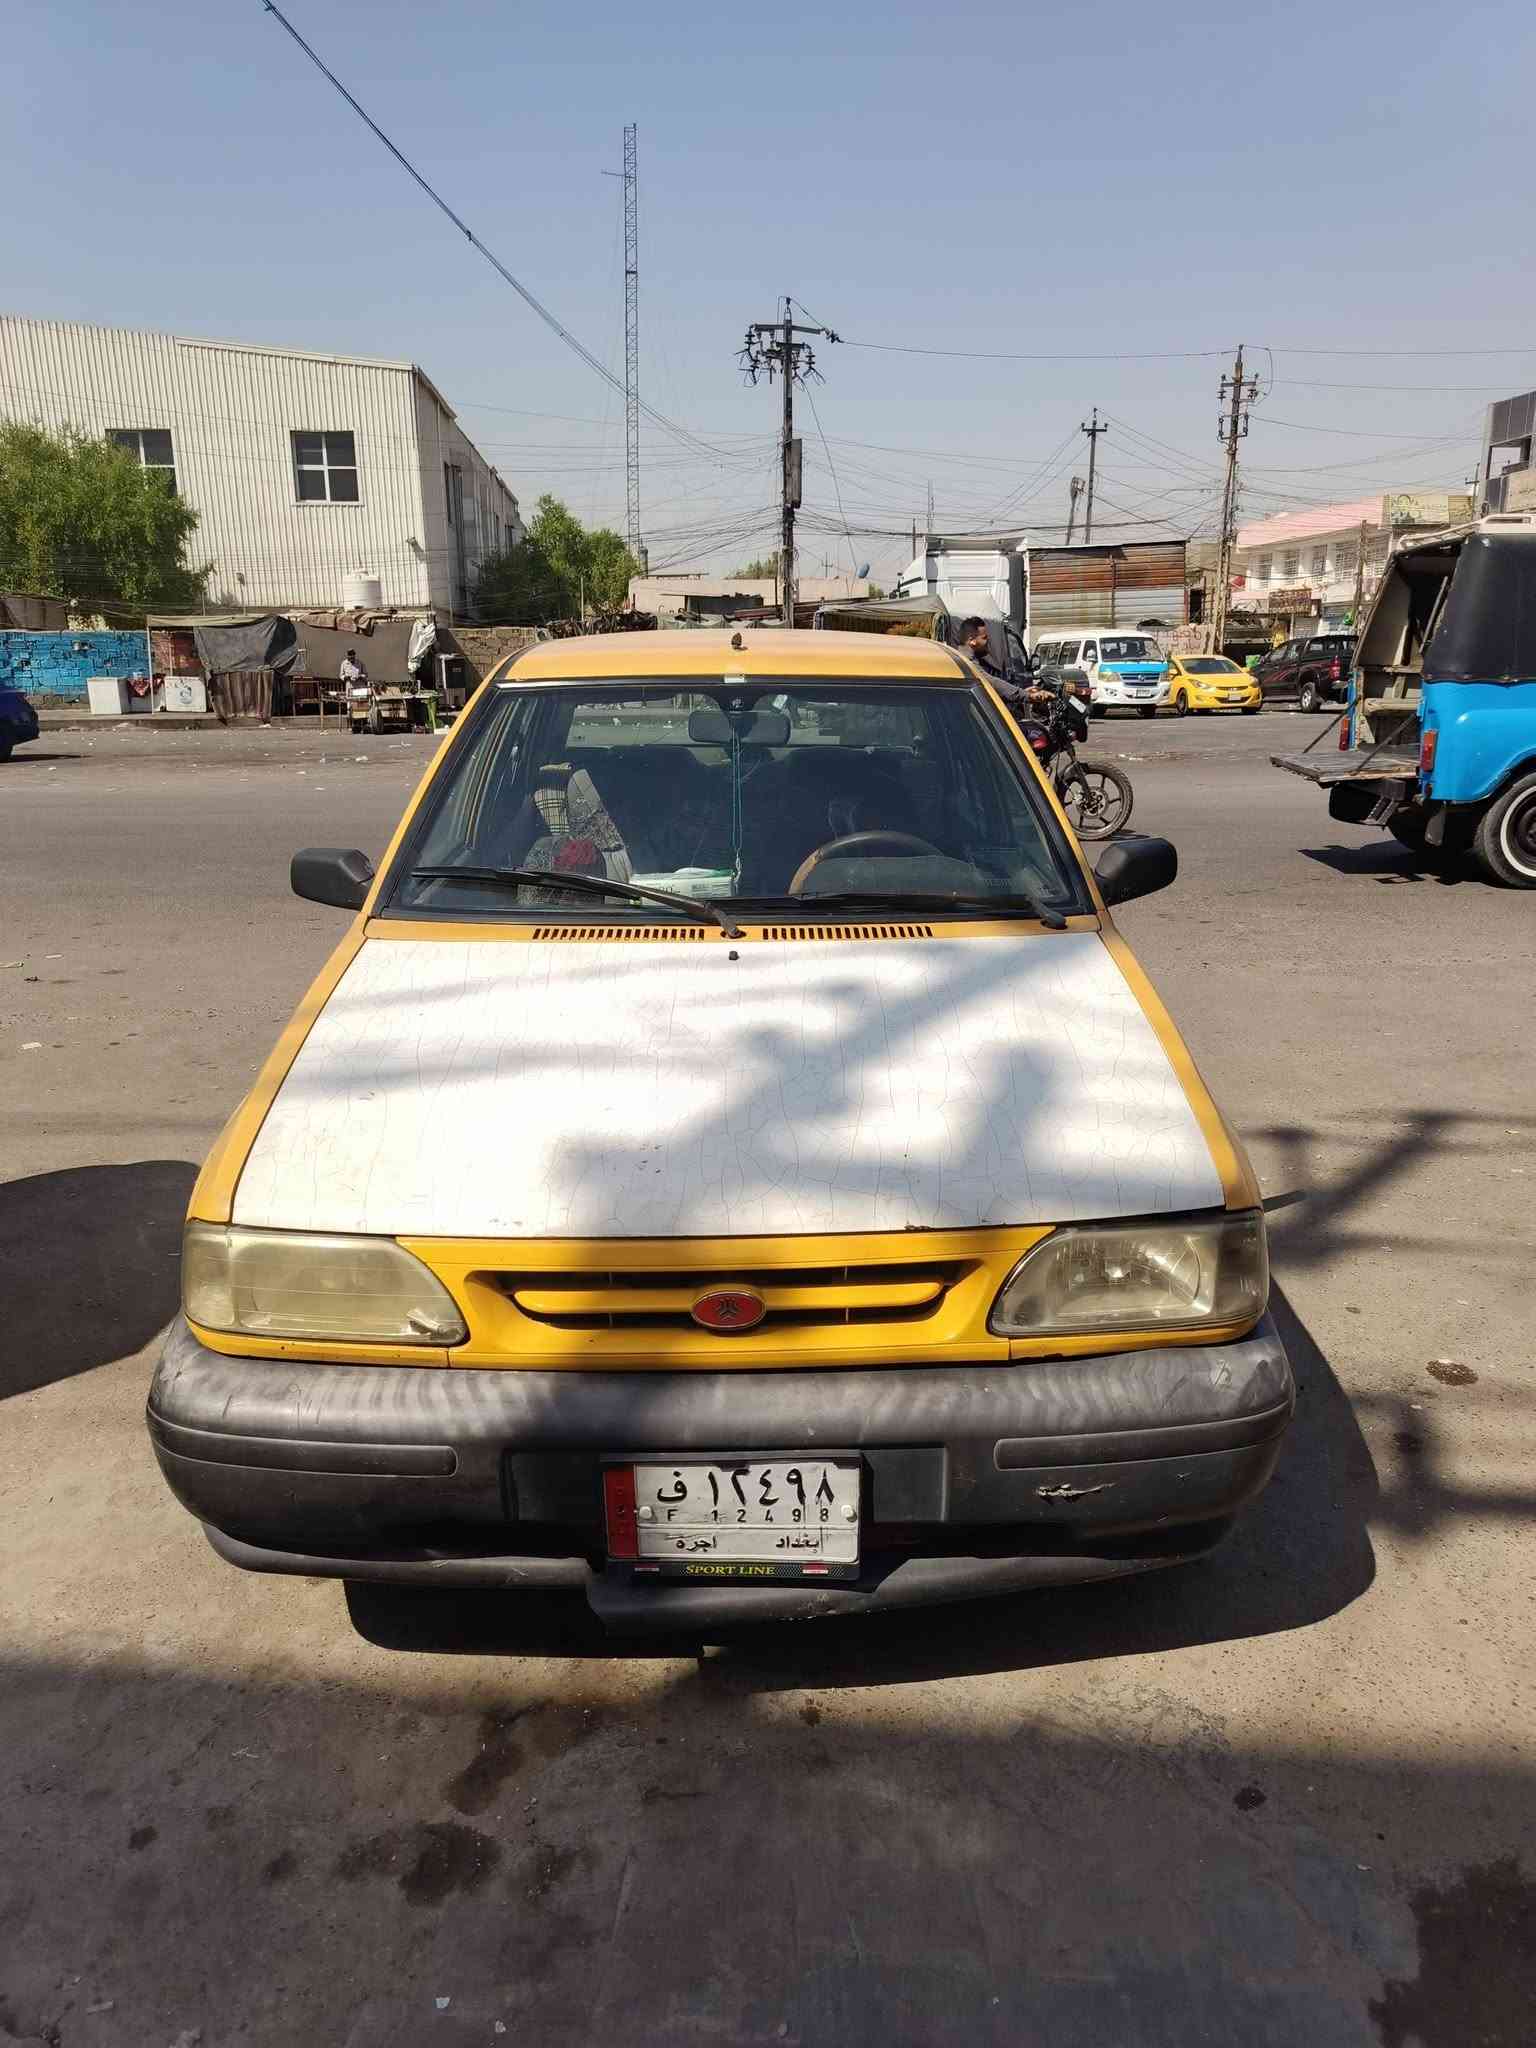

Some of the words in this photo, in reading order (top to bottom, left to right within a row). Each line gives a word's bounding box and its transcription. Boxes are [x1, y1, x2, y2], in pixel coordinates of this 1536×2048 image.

[775, 1534, 820, 1554] بغداد
[686, 1564, 737, 1576] SPORT
[739, 1565, 777, 1577] LINE
